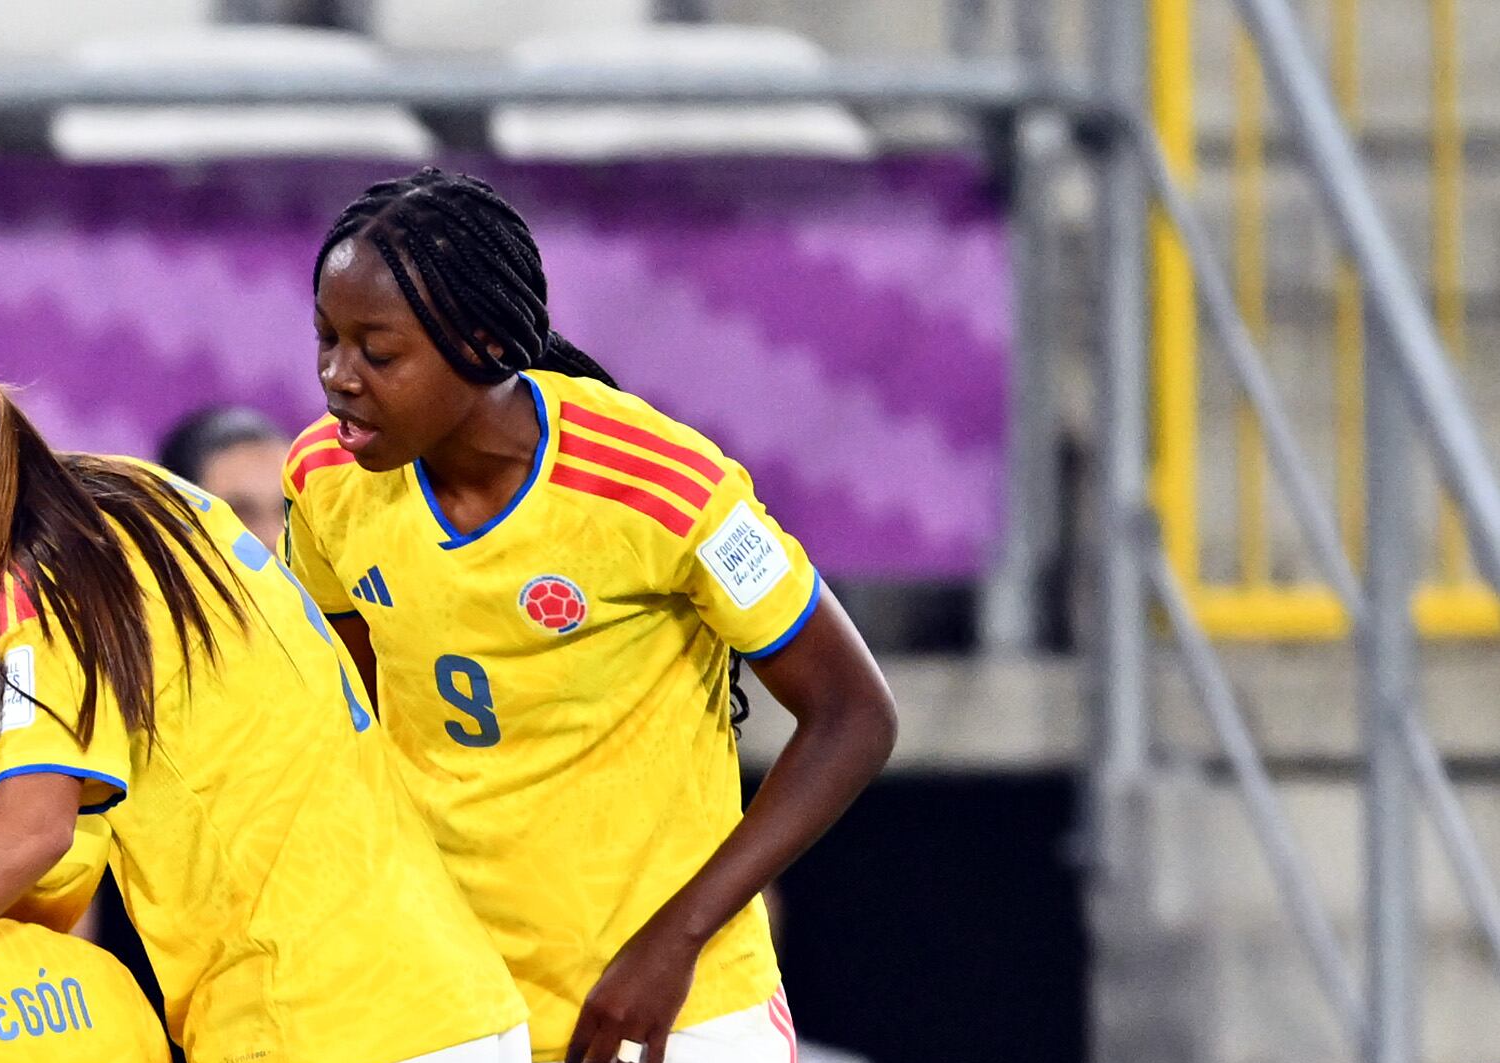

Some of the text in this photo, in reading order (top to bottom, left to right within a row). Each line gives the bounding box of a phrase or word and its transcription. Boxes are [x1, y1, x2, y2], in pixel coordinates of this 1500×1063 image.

[714, 520, 752, 560] FOOTBALL
[722, 529, 762, 573] UNITES
[733, 540, 774, 586] the World
[434, 654, 501, 748] 9
